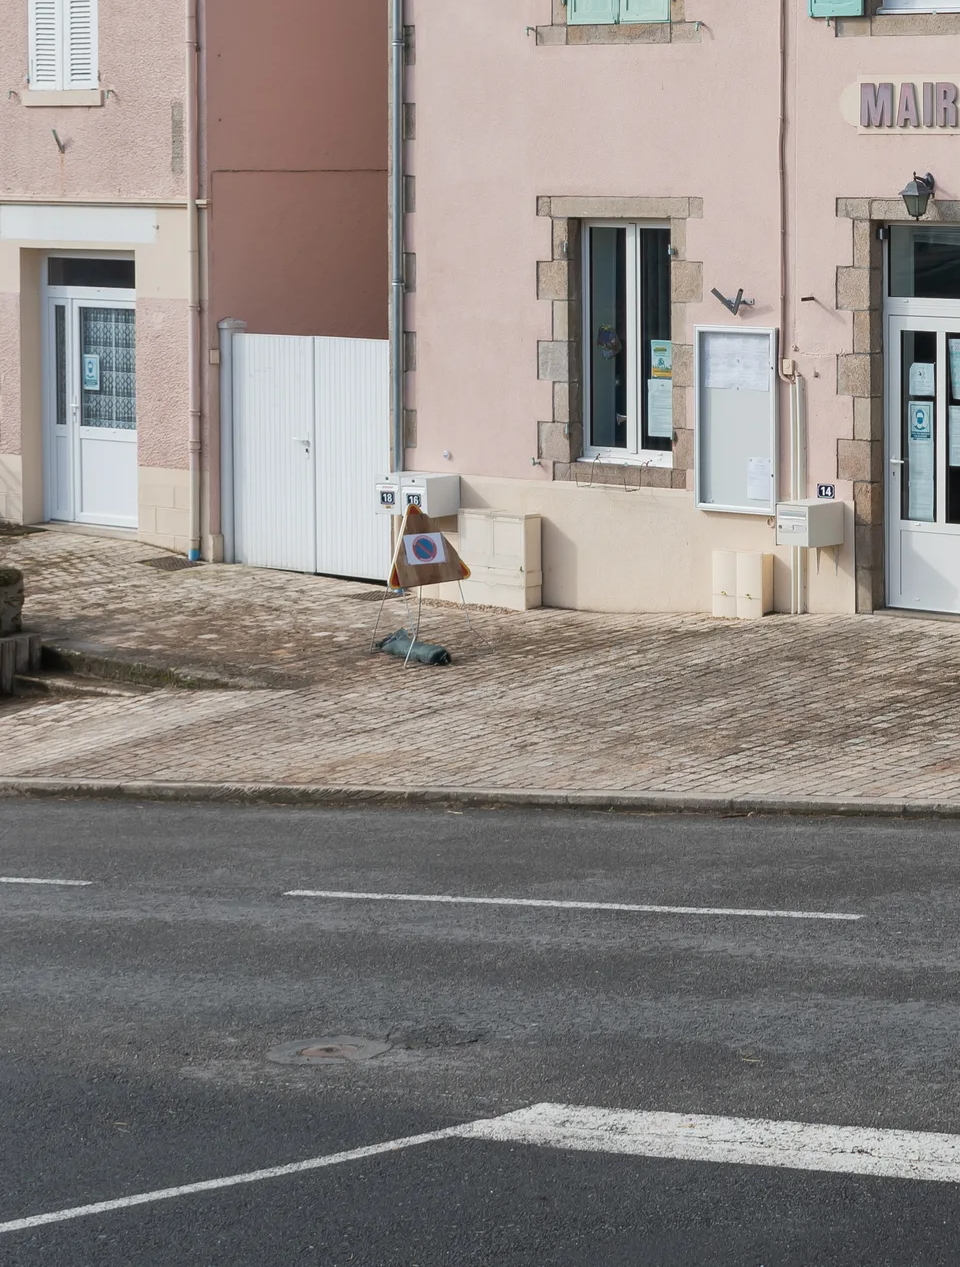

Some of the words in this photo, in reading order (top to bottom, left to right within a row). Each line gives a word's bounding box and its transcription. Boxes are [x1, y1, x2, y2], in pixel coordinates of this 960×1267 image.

[820, 486, 832, 497] 14
[382, 493, 393, 503] 18
[408, 496, 419, 505] 16
